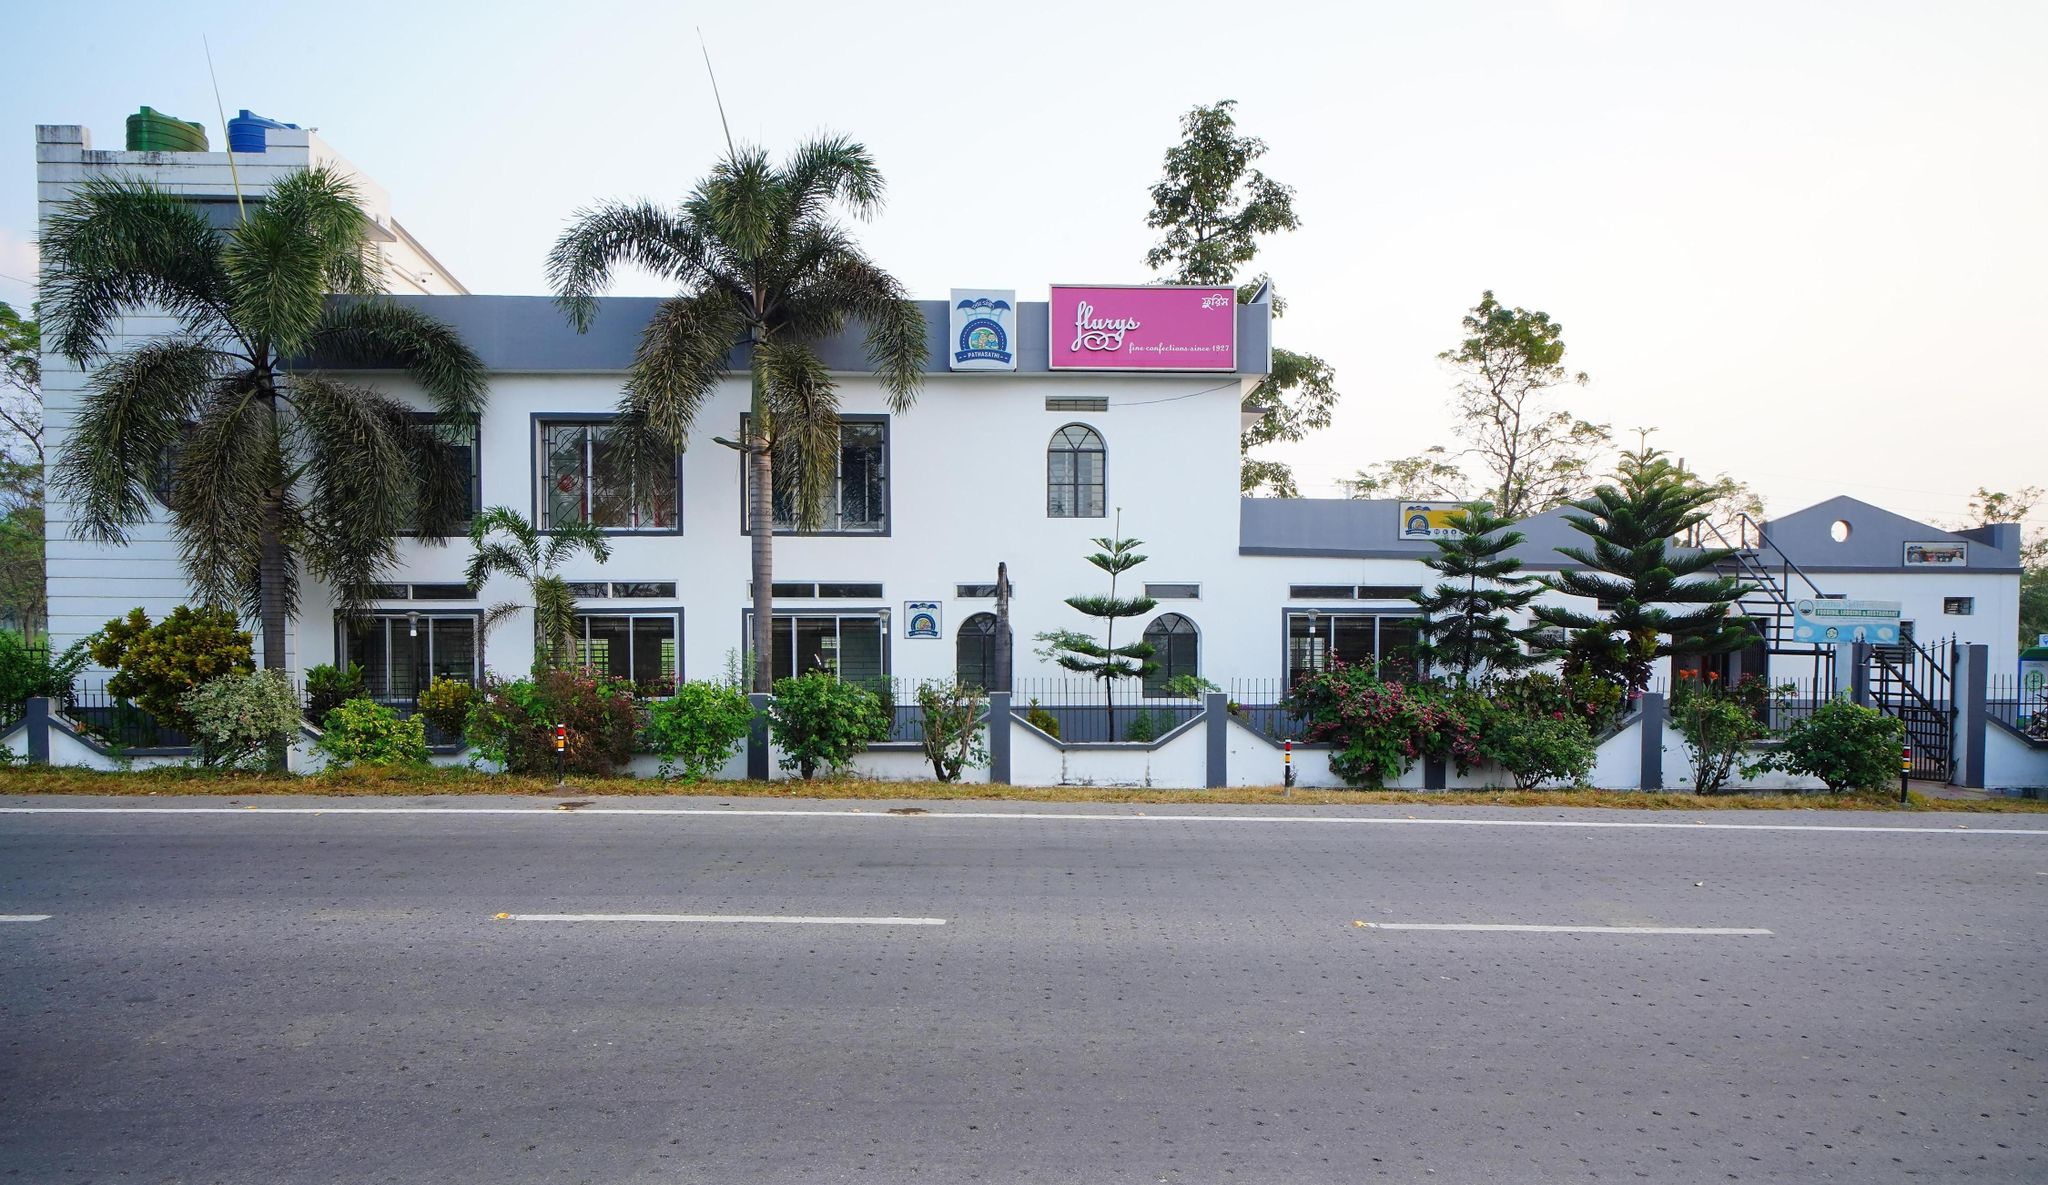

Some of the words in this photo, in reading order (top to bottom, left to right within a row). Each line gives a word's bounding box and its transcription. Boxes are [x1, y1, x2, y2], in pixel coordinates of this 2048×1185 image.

[1071, 301, 1141, 352] flurys
[1129, 342, 1144, 354] fine
[1145, 342, 1187, 354] confections
